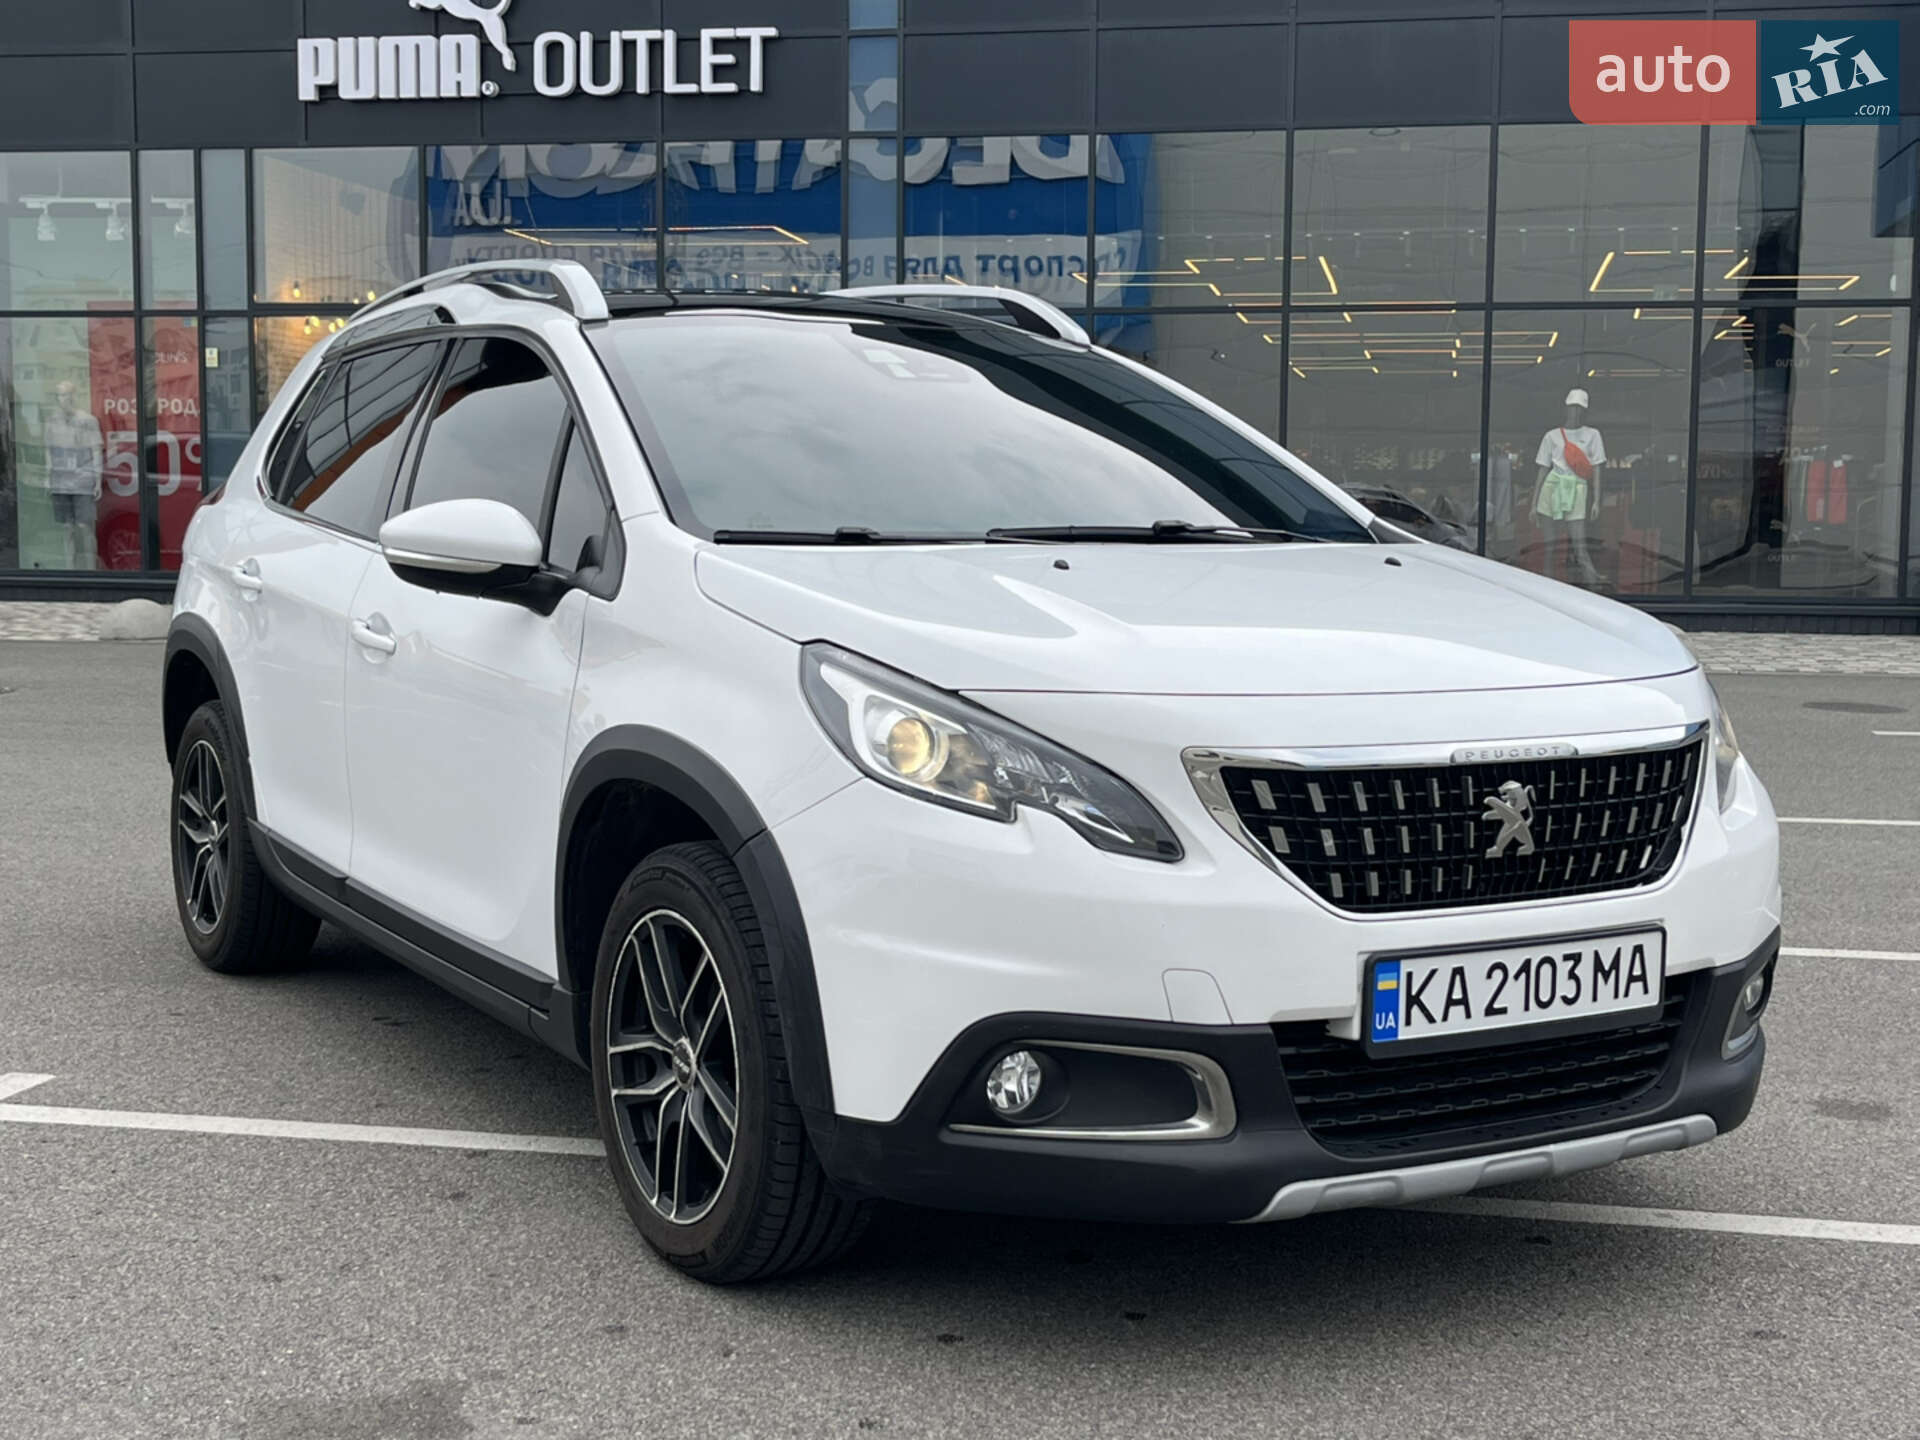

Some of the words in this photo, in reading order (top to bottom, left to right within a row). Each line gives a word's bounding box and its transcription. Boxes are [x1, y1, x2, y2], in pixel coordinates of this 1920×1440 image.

[297, 34, 482, 100] PUMA
[532, 26, 779, 97] OUTLET
[1465, 746, 1560, 761] PEUGEOT
[1484, 952, 1583, 1017] 2103
[1376, 1013, 1397, 1030] UA
